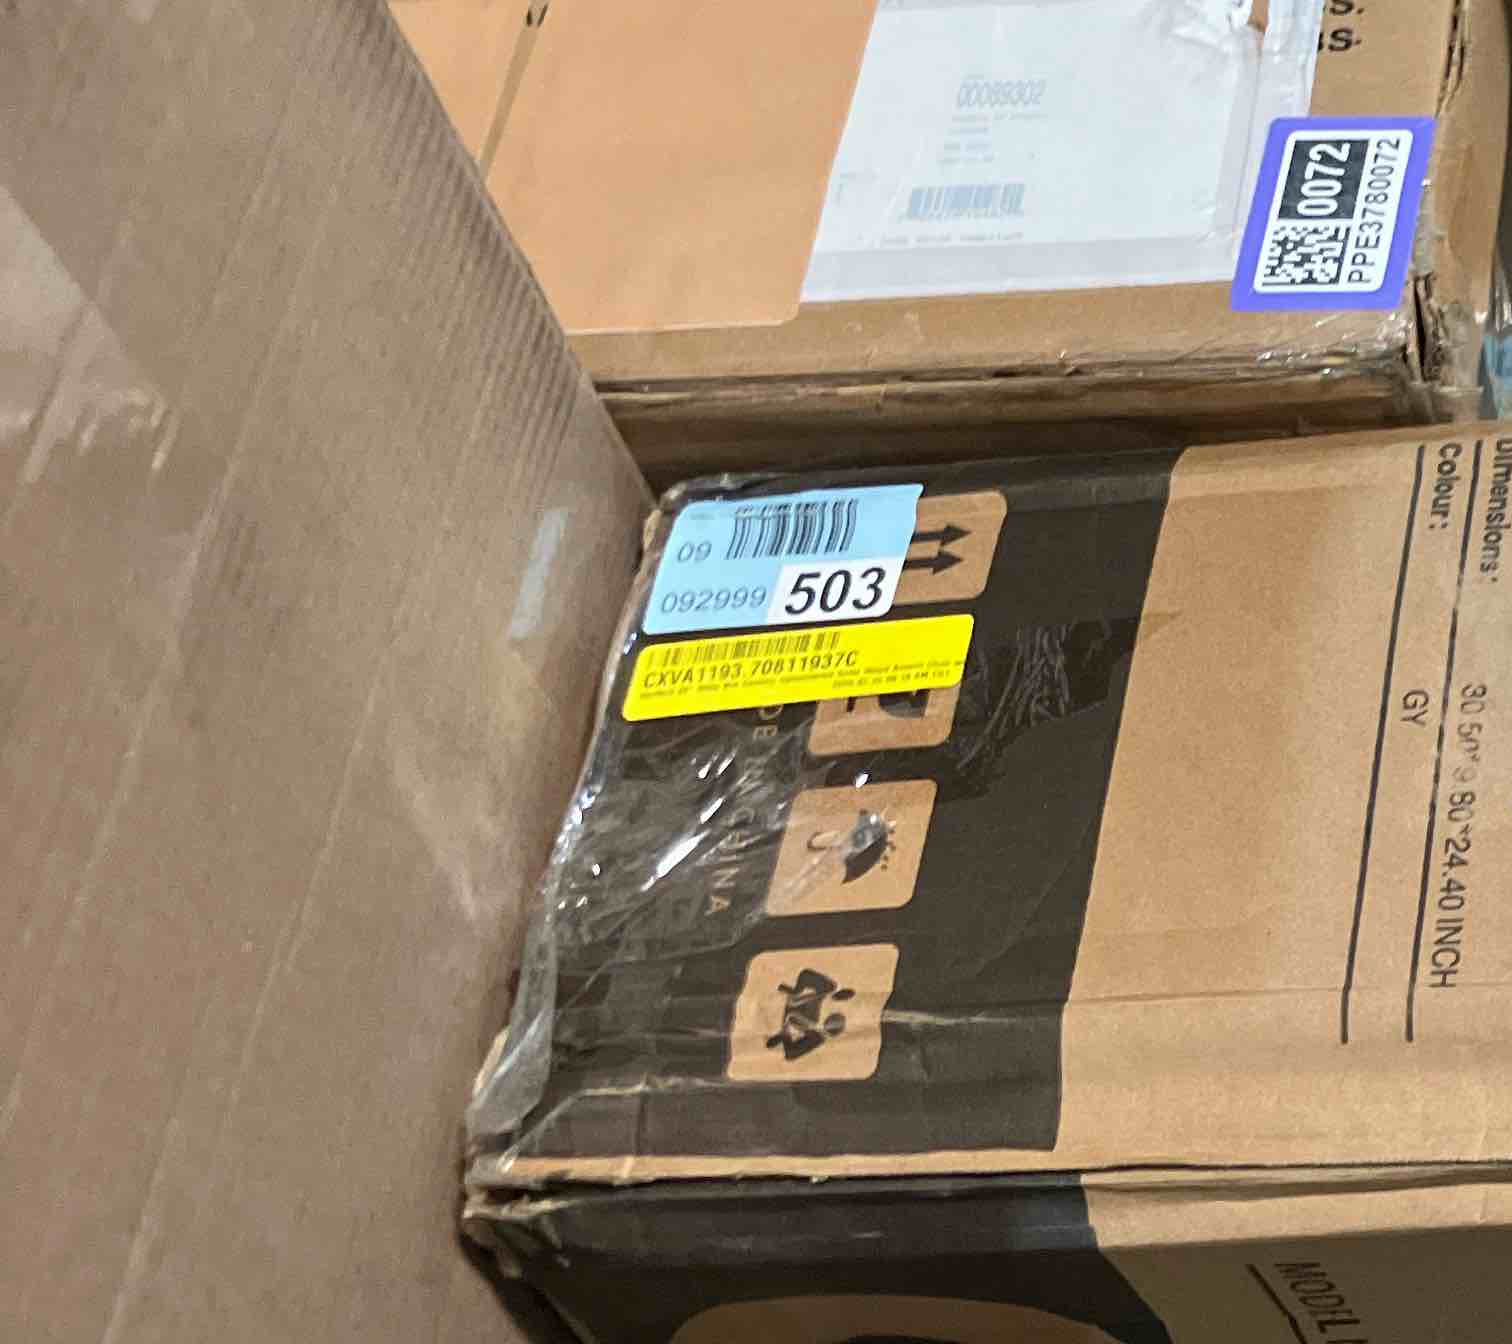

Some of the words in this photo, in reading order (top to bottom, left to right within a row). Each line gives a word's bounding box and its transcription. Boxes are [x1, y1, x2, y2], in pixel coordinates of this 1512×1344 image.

[1296, 141, 1351, 217] 0072
[1347, 137, 1402, 284] PPE3780072
[1424, 442, 1465, 531] Colour:
[676, 540, 713, 564] 09
[658, 585, 768, 615] 092999
[784, 566, 888, 616] 503
[1400, 687, 1431, 729] GY
[1428, 917, 1464, 990] INCH
